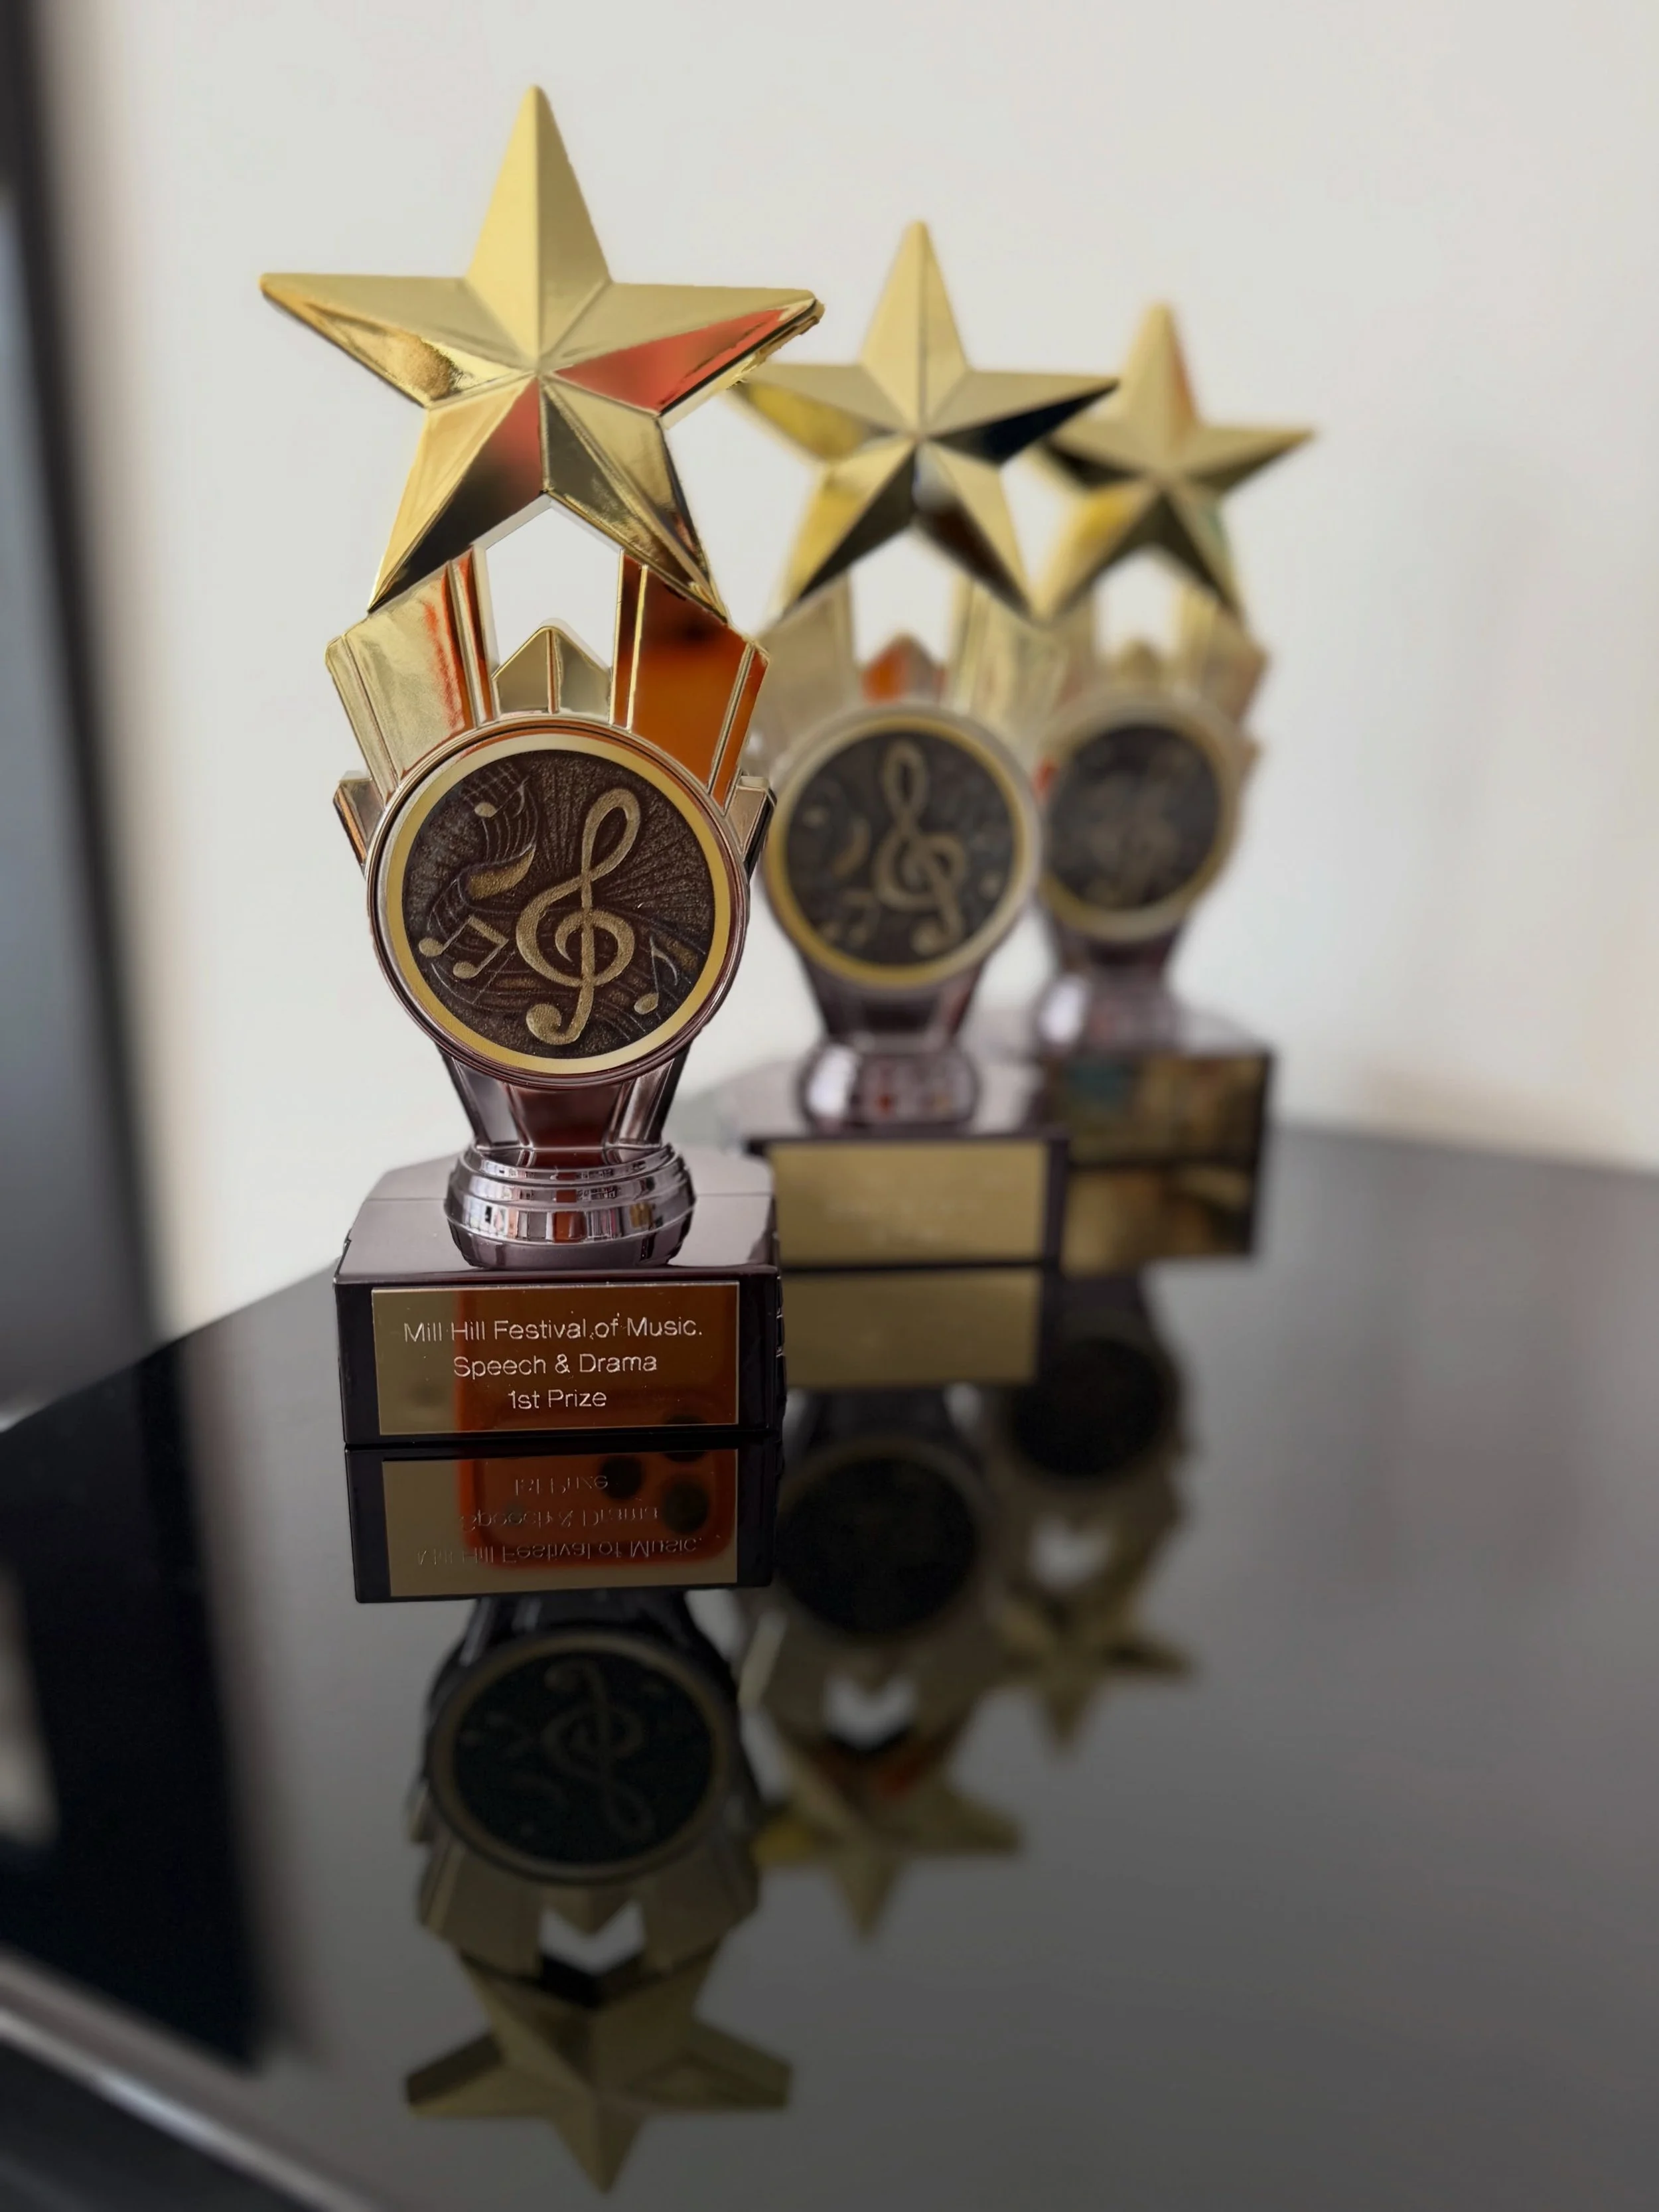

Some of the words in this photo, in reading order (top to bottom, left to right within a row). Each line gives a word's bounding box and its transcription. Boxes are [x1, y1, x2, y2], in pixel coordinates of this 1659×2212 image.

[403, 1321, 442, 1343] Mill
[451, 1320, 486, 1341] Hill
[494, 1318, 587, 1340] Festival
[595, 1317, 618, 1338] of
[454, 1356, 546, 1380] Speech
[555, 1353, 571, 1374] &
[579, 1353, 658, 1373] Drama
[508, 1390, 540, 1410] 1st
[548, 1389, 607, 1408] Prize
